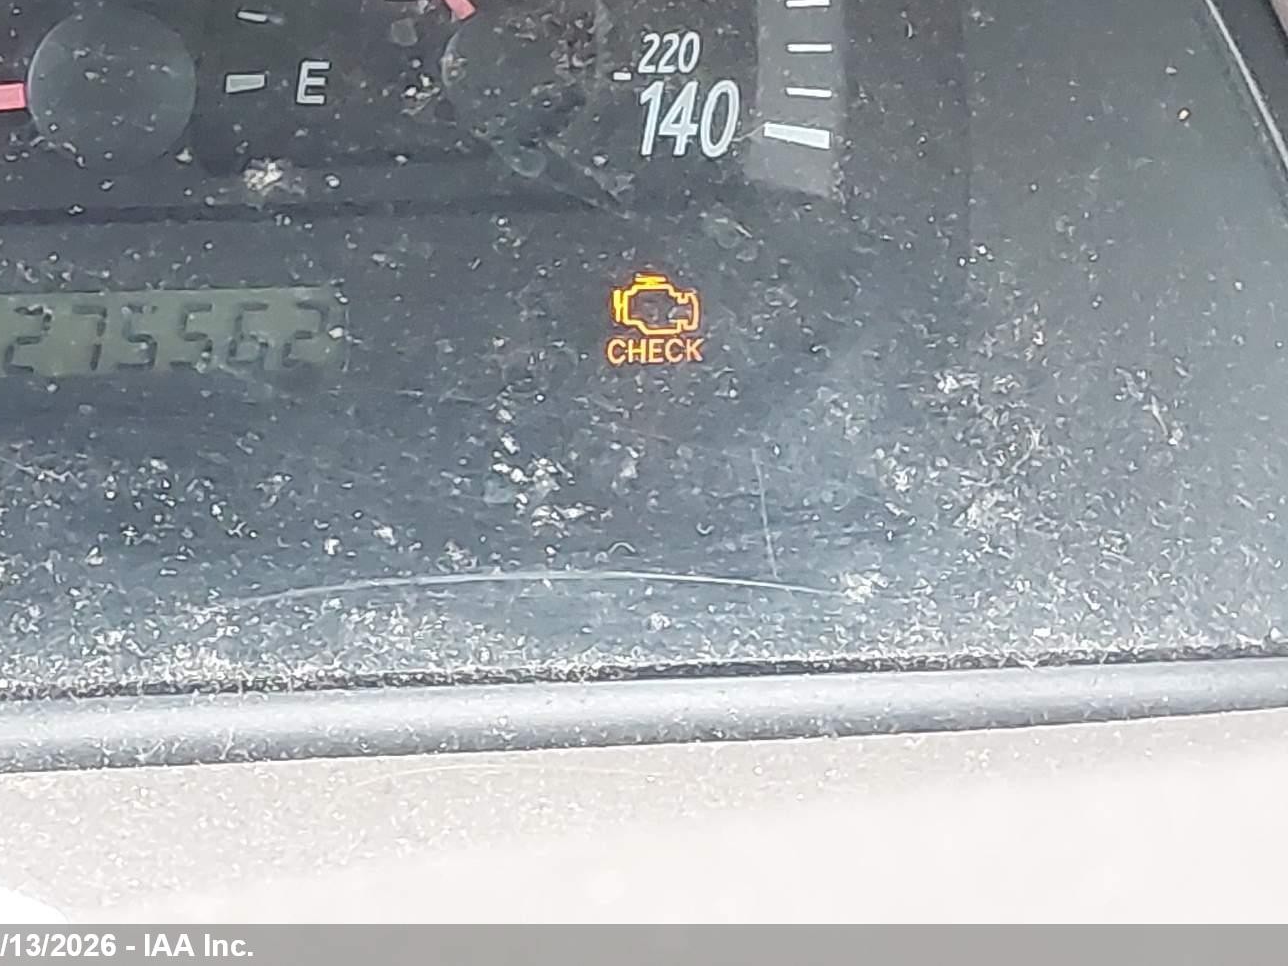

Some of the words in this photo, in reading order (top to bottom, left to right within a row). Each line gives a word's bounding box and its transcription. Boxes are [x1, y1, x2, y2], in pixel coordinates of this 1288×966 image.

[638, 30, 700, 74] 220
[297, 61, 330, 106] E
[639, 79, 741, 157] 140
[4, 300, 330, 374] 275562
[606, 338, 704, 365] CHECK
